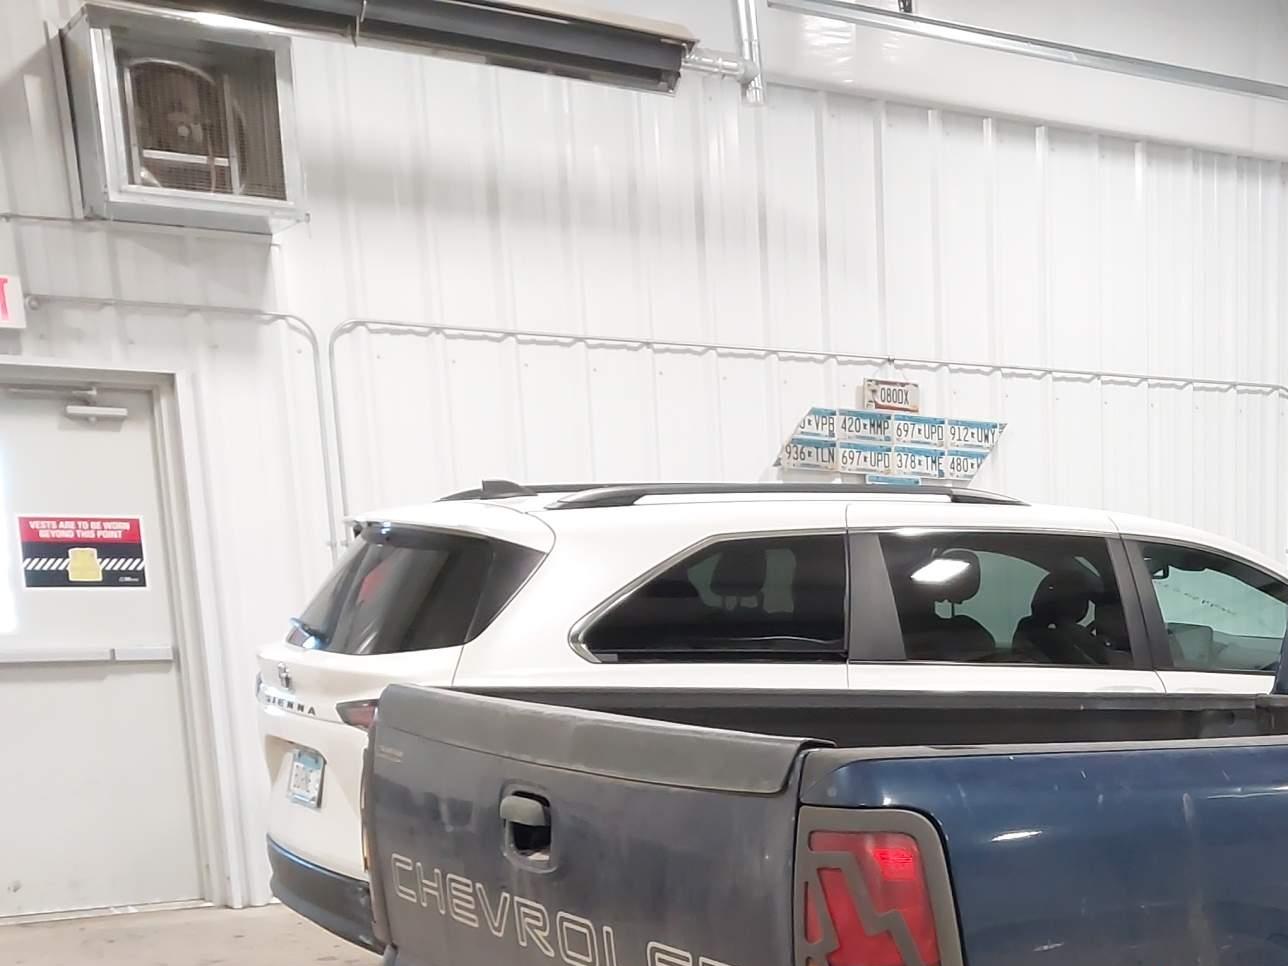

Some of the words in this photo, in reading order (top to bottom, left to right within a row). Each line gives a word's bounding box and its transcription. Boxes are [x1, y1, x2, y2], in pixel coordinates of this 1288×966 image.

[841, 416, 861, 433] 420
[896, 423, 916, 438] 697
[949, 426, 969, 442] 912
[785, 445, 806, 461] 936
[841, 450, 862, 466] 697
[896, 454, 916, 469] 378
[949, 457, 969, 472] 480
[29, 520, 57, 529] VESTS
[58, 521, 76, 530] ARE
[77, 521, 88, 530] TO
[39, 529, 74, 538] BEYOND
[76, 530, 95, 538] THIS
[97, 530, 123, 538] POINT
[264, 694, 317, 716] SIENNA
